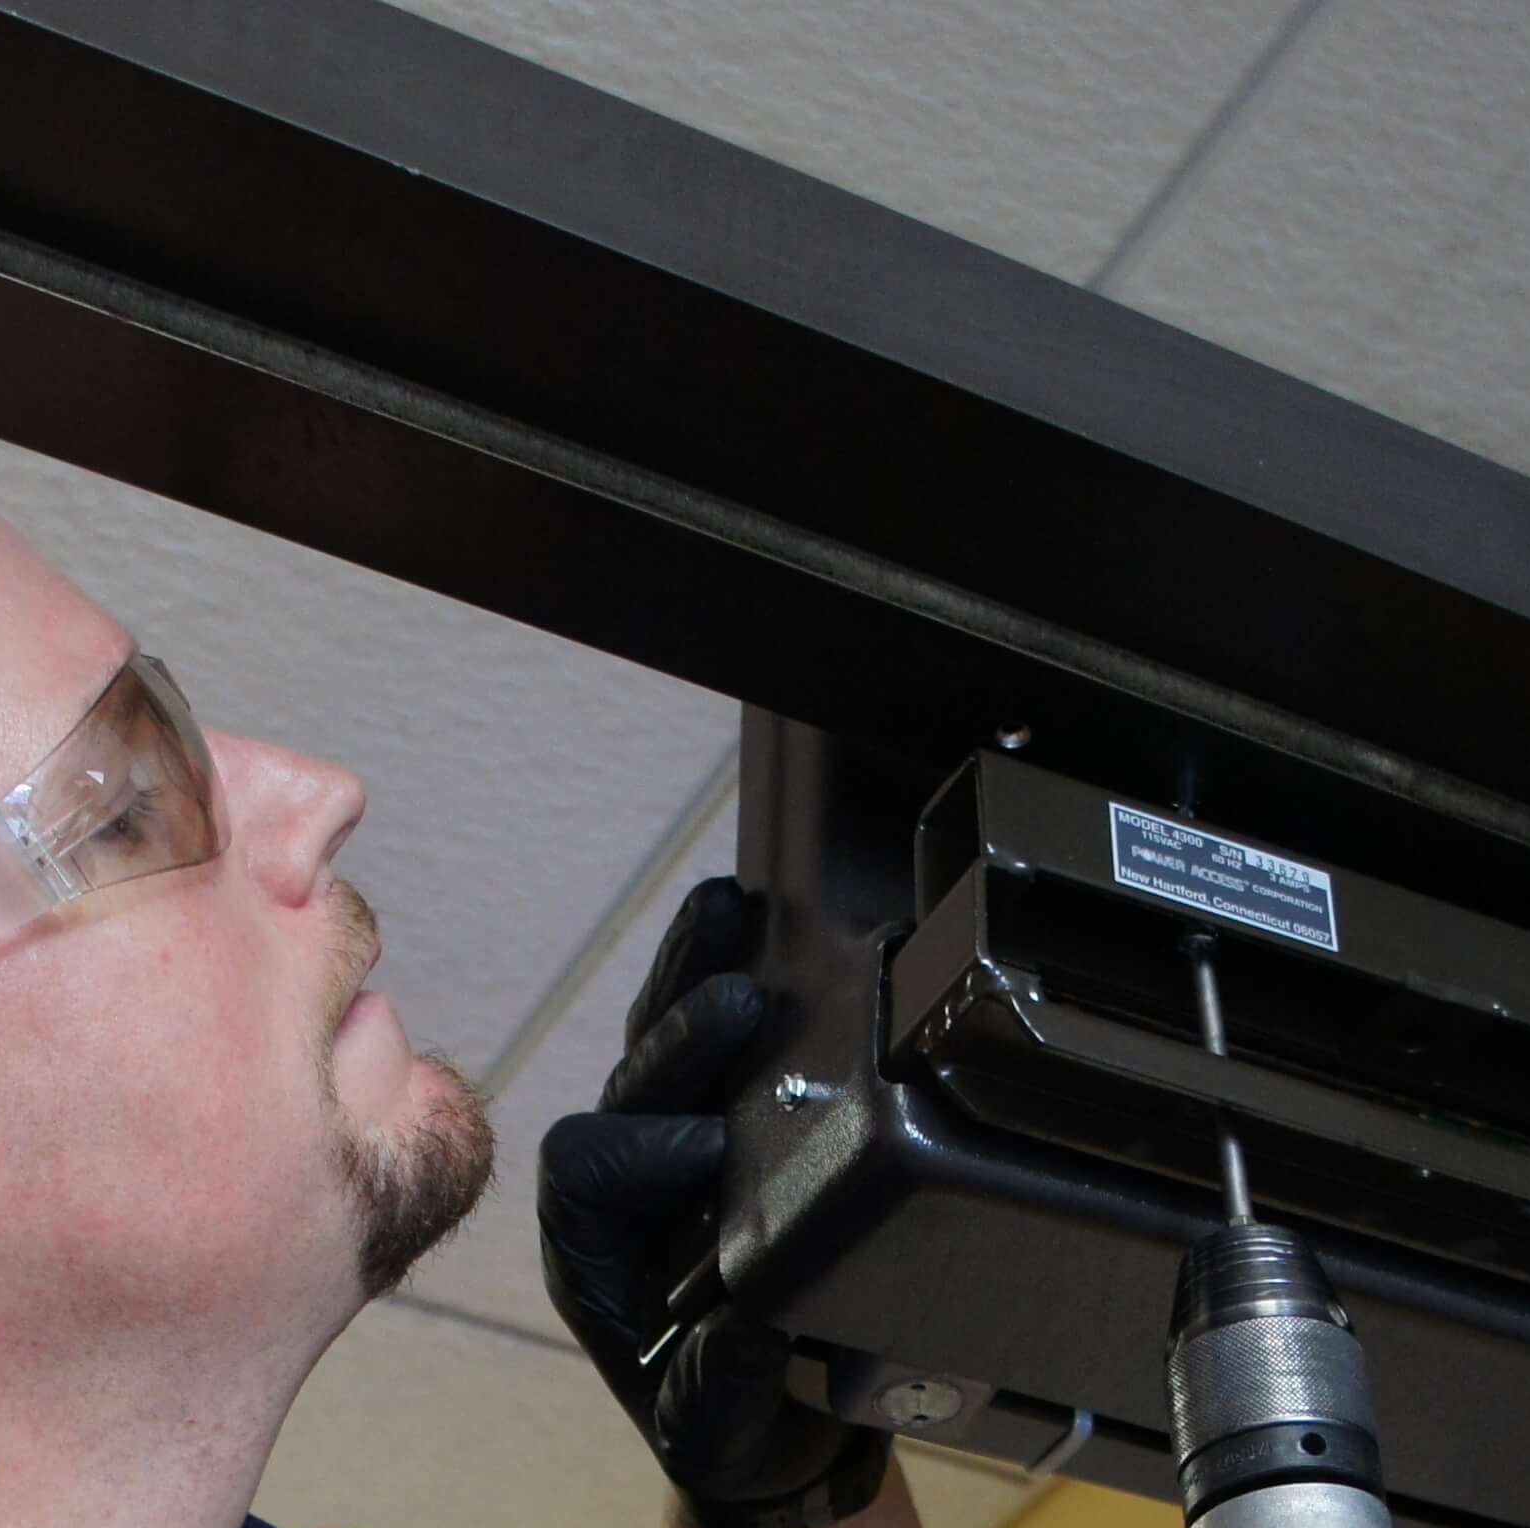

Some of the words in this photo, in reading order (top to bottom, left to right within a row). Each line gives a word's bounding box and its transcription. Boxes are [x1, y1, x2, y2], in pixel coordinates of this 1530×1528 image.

[1118, 811, 1169, 837] MODEL
[1172, 830, 1203, 848] 4300
[1219, 845, 1242, 860] S/N
[1142, 831, 1182, 850] 115VAC
[1278, 876, 1311, 893] AMPS
[1121, 866, 1150, 885] New
[1153, 876, 1210, 905] Hartford,
[1213, 897, 1290, 931] Connecticut
[1293, 923, 1330, 942] 06057
[1131, 845, 1186, 872] POWER
[1252, 884, 1323, 914] CORPORATION
